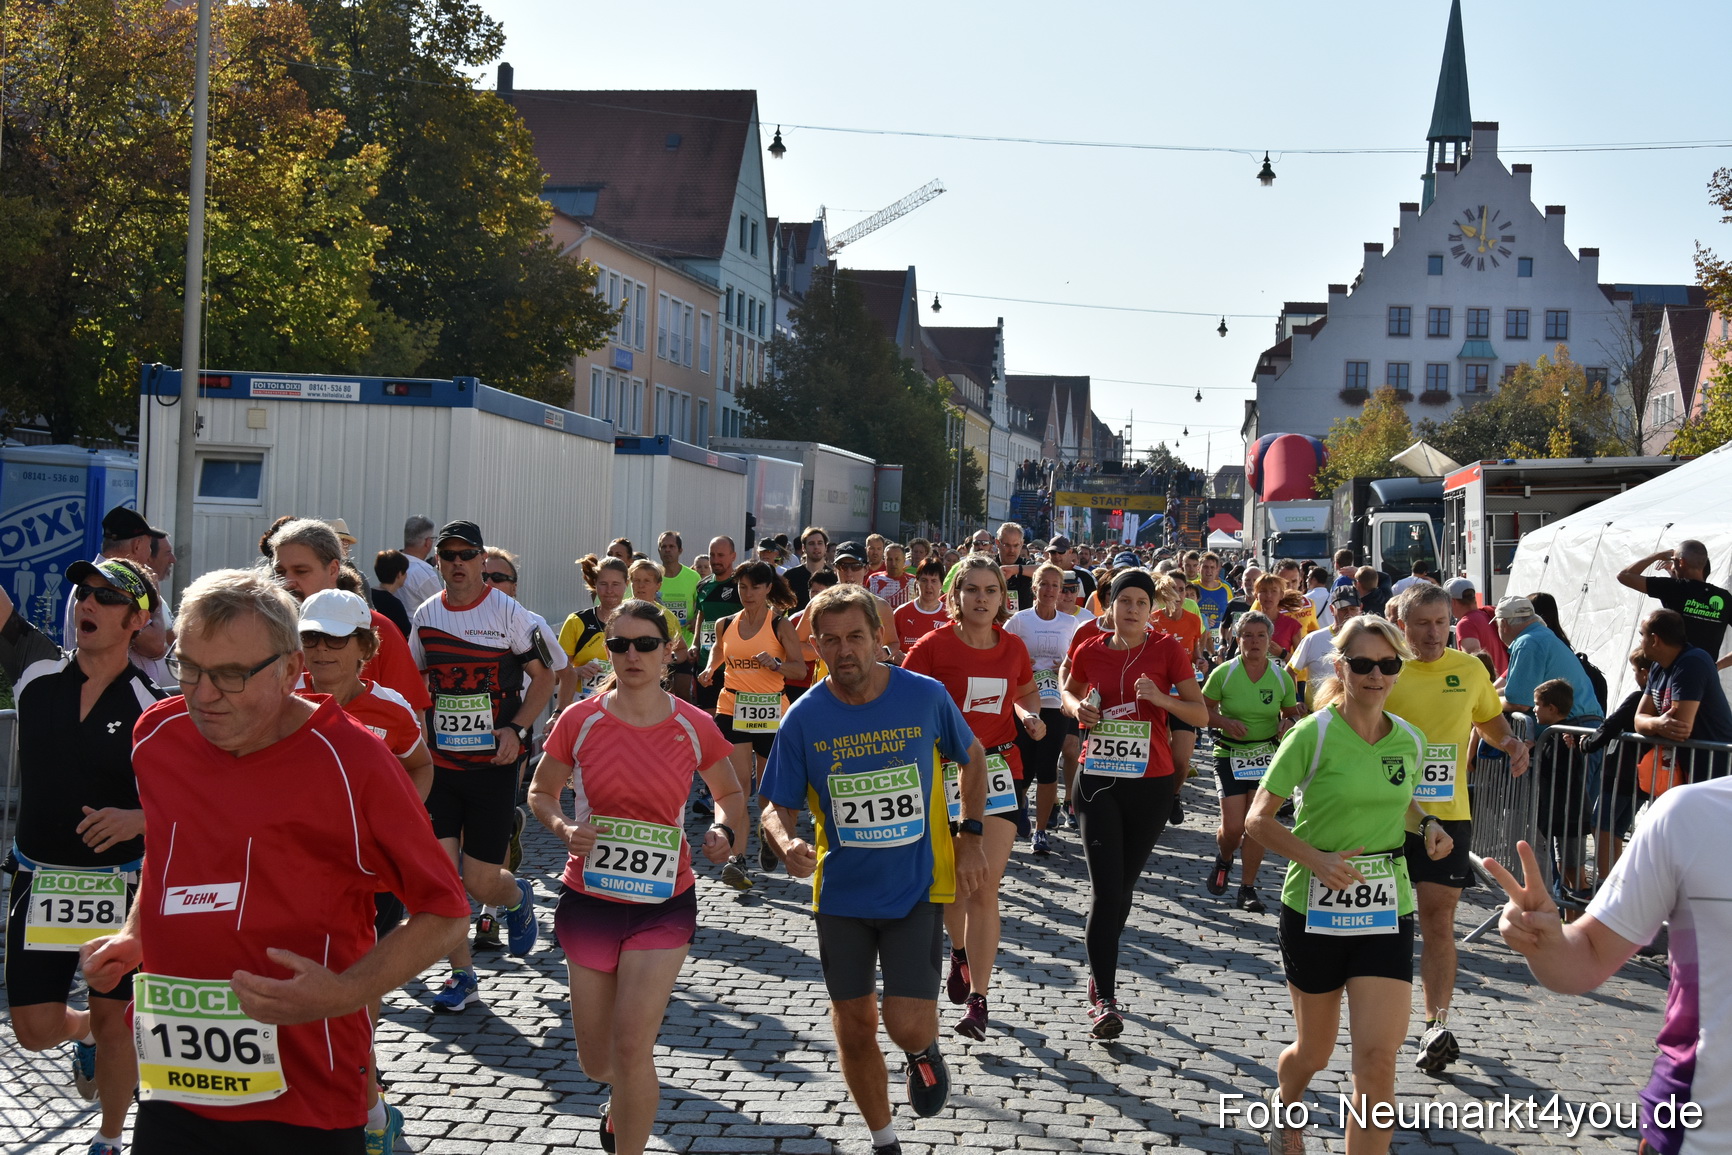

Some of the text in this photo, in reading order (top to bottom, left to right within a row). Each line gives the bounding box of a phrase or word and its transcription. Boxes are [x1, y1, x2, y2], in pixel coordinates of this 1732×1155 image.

[307, 391, 352, 399] www.toitoidixi.de
[330, 384, 342, 392] 536
[22, 471, 46, 481] 08141
[53, 473, 68, 483] 536
[69, 474, 79, 483] 80
[1091, 496, 1130, 507] START
[1683, 606, 1721, 619] neumarkt
[726, 656, 761, 669] ARBE
[1037, 678, 1058, 690] 215
[437, 697, 486, 710] BOCK
[740, 694, 777, 703] BOCK
[740, 707, 776, 719] 1303
[439, 715, 486, 732] 2324
[1093, 722, 1144, 737] BOCK
[444, 735, 482, 745] JÜRGEN
[813, 726, 923, 753] 10. NEUMARKTER
[832, 740, 907, 761] STADTLAUF
[1092, 738, 1142, 759] 2564
[1425, 747, 1452, 760] CK
[947, 757, 1004, 778] BK
[1093, 760, 1138, 772] RAPHAEL
[1236, 755, 1272, 769] 2486
[1239, 769, 1267, 777] CHRIST
[1422, 765, 1449, 782] 63
[836, 770, 912, 794] BOCK
[1414, 787, 1437, 795] ANS
[842, 795, 914, 823] 2138
[597, 820, 672, 847] BOCK
[854, 825, 908, 840] RUDOLF
[595, 845, 667, 876] 2287
[1346, 857, 1389, 877] CK
[38, 873, 117, 892] BOCK
[600, 877, 654, 894] SIMONE
[182, 892, 218, 906] DEHN
[1318, 883, 1388, 908] 2484
[40, 898, 115, 924] 1358
[1331, 915, 1373, 926] HEIKE
[150, 1023, 270, 1065] 1306 C
[168, 1071, 251, 1092] ROBERT
